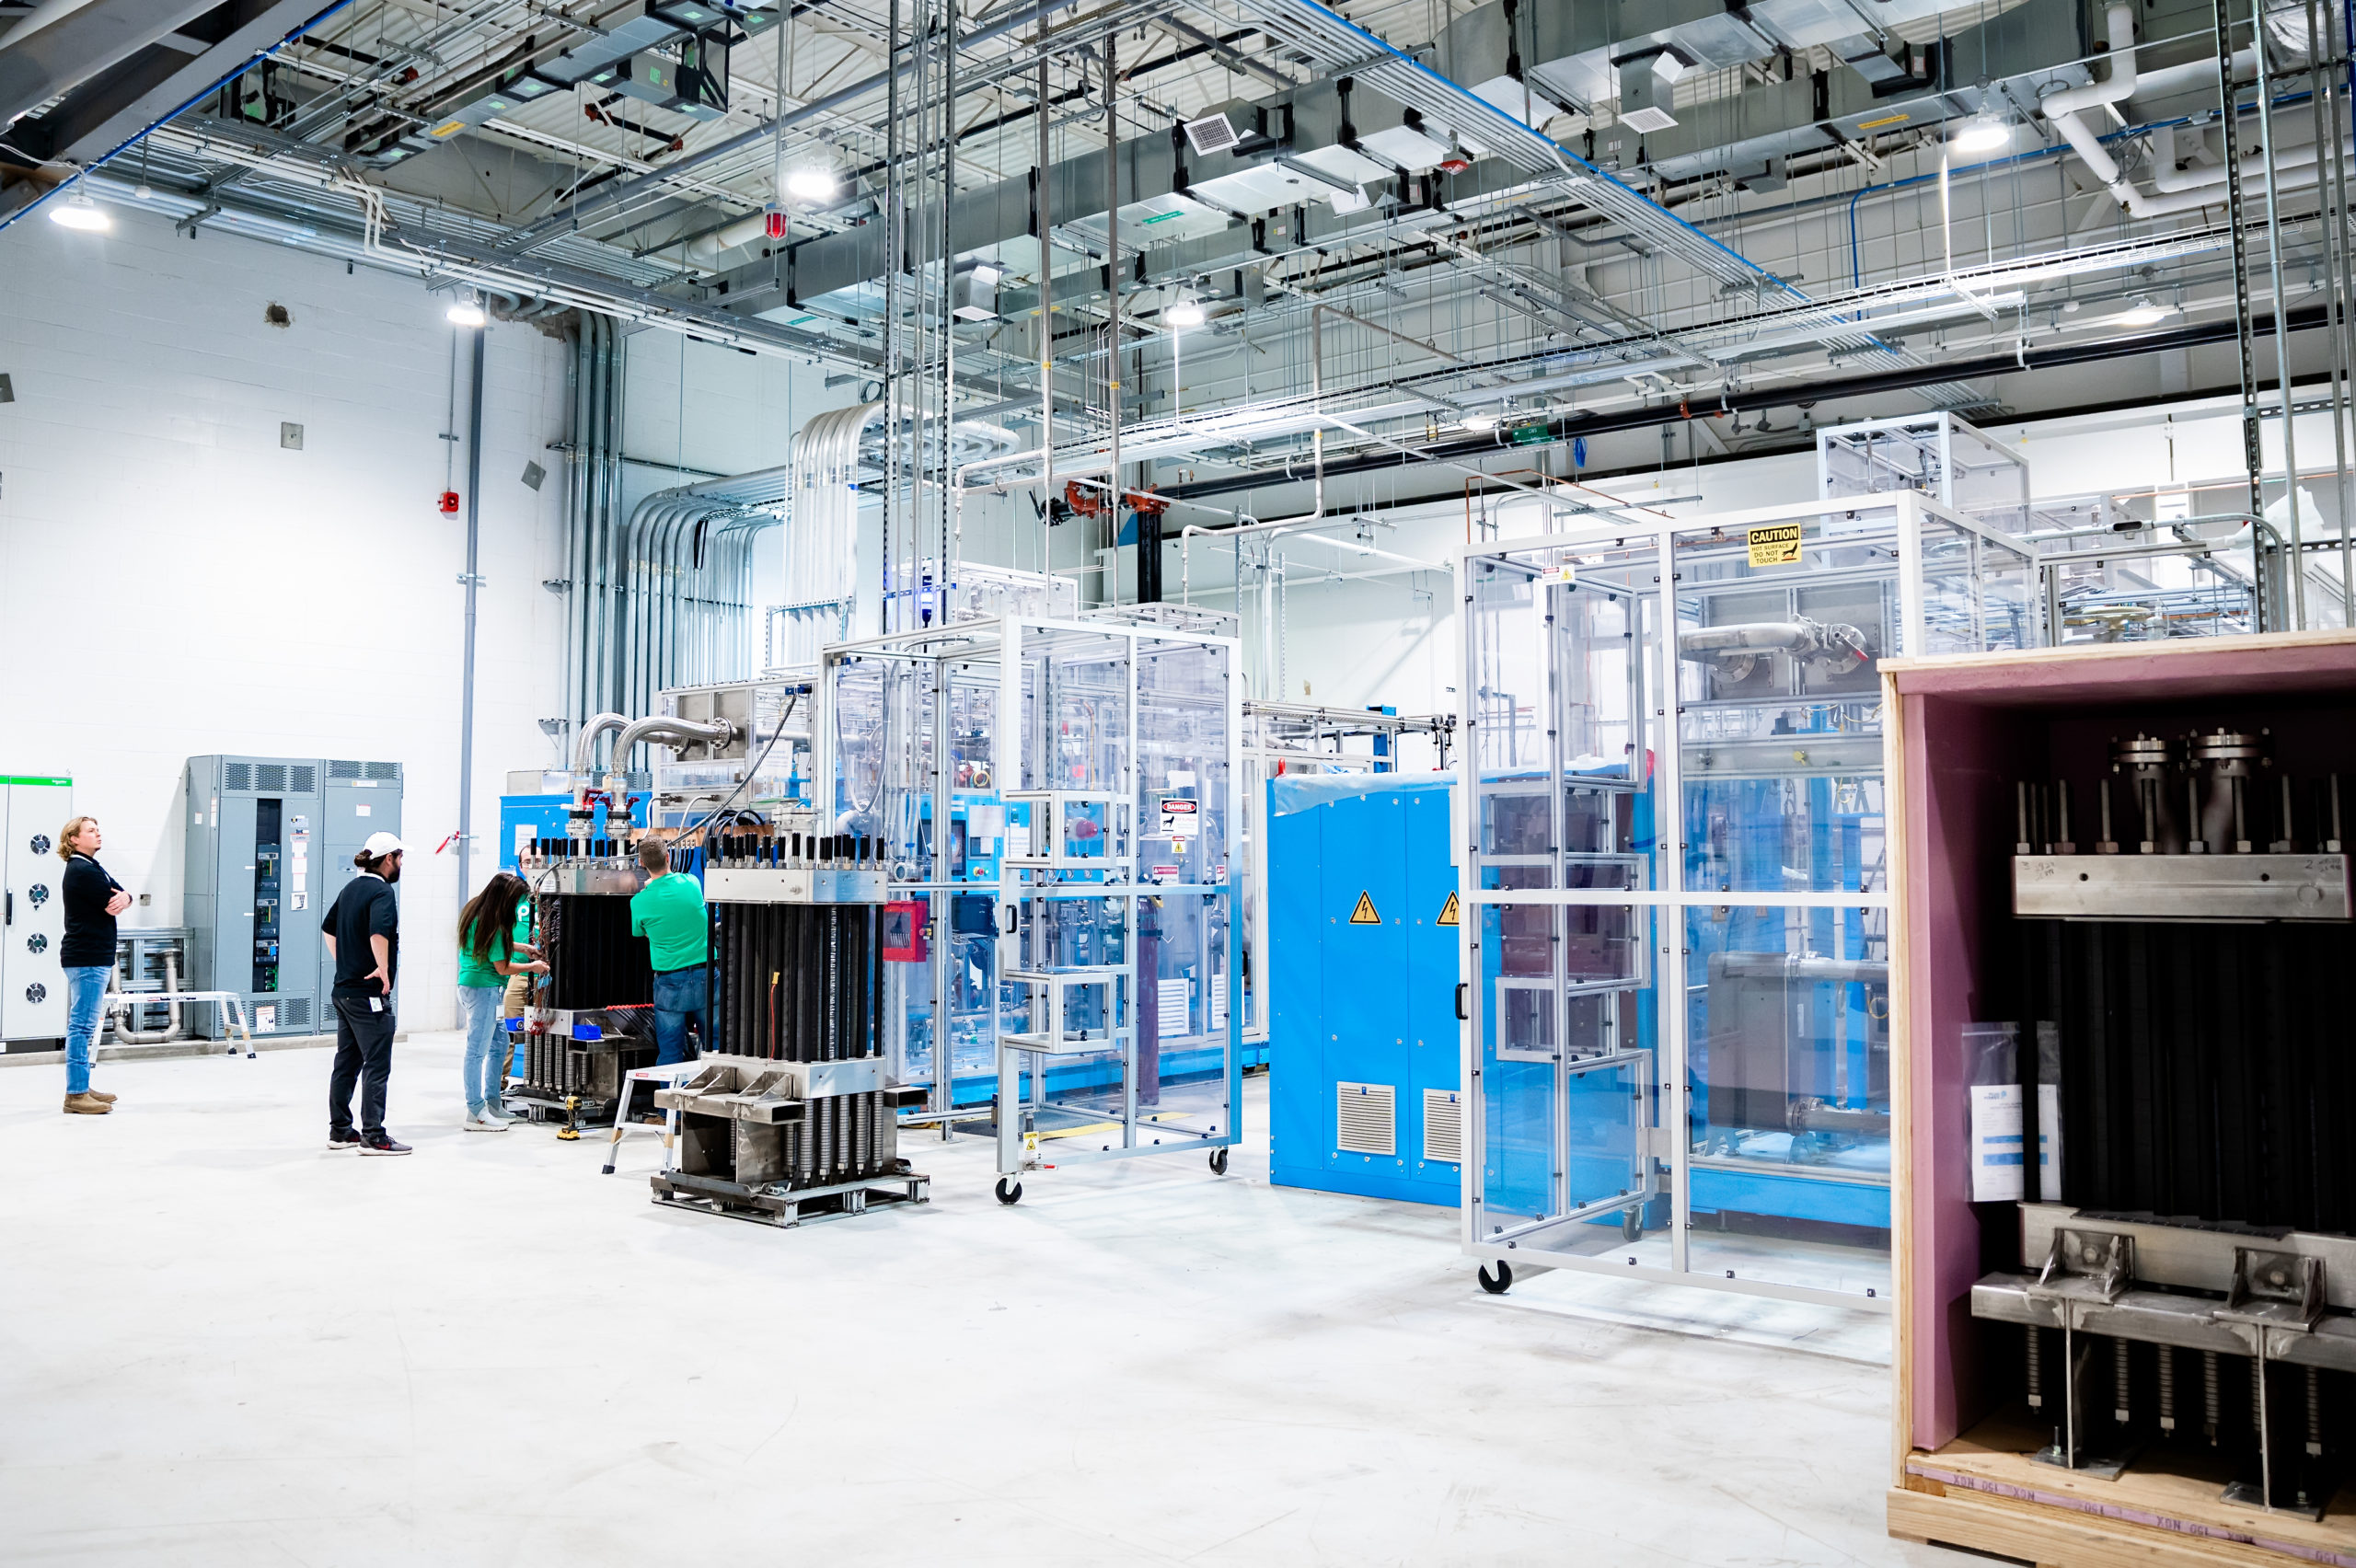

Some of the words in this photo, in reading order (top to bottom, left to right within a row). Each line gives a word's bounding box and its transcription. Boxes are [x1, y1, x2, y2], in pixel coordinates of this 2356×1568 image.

[1751, 528, 1797, 543] CAUTION
[1982, 1481, 1998, 1493] 150
[2190, 1524, 2210, 1536] 150
